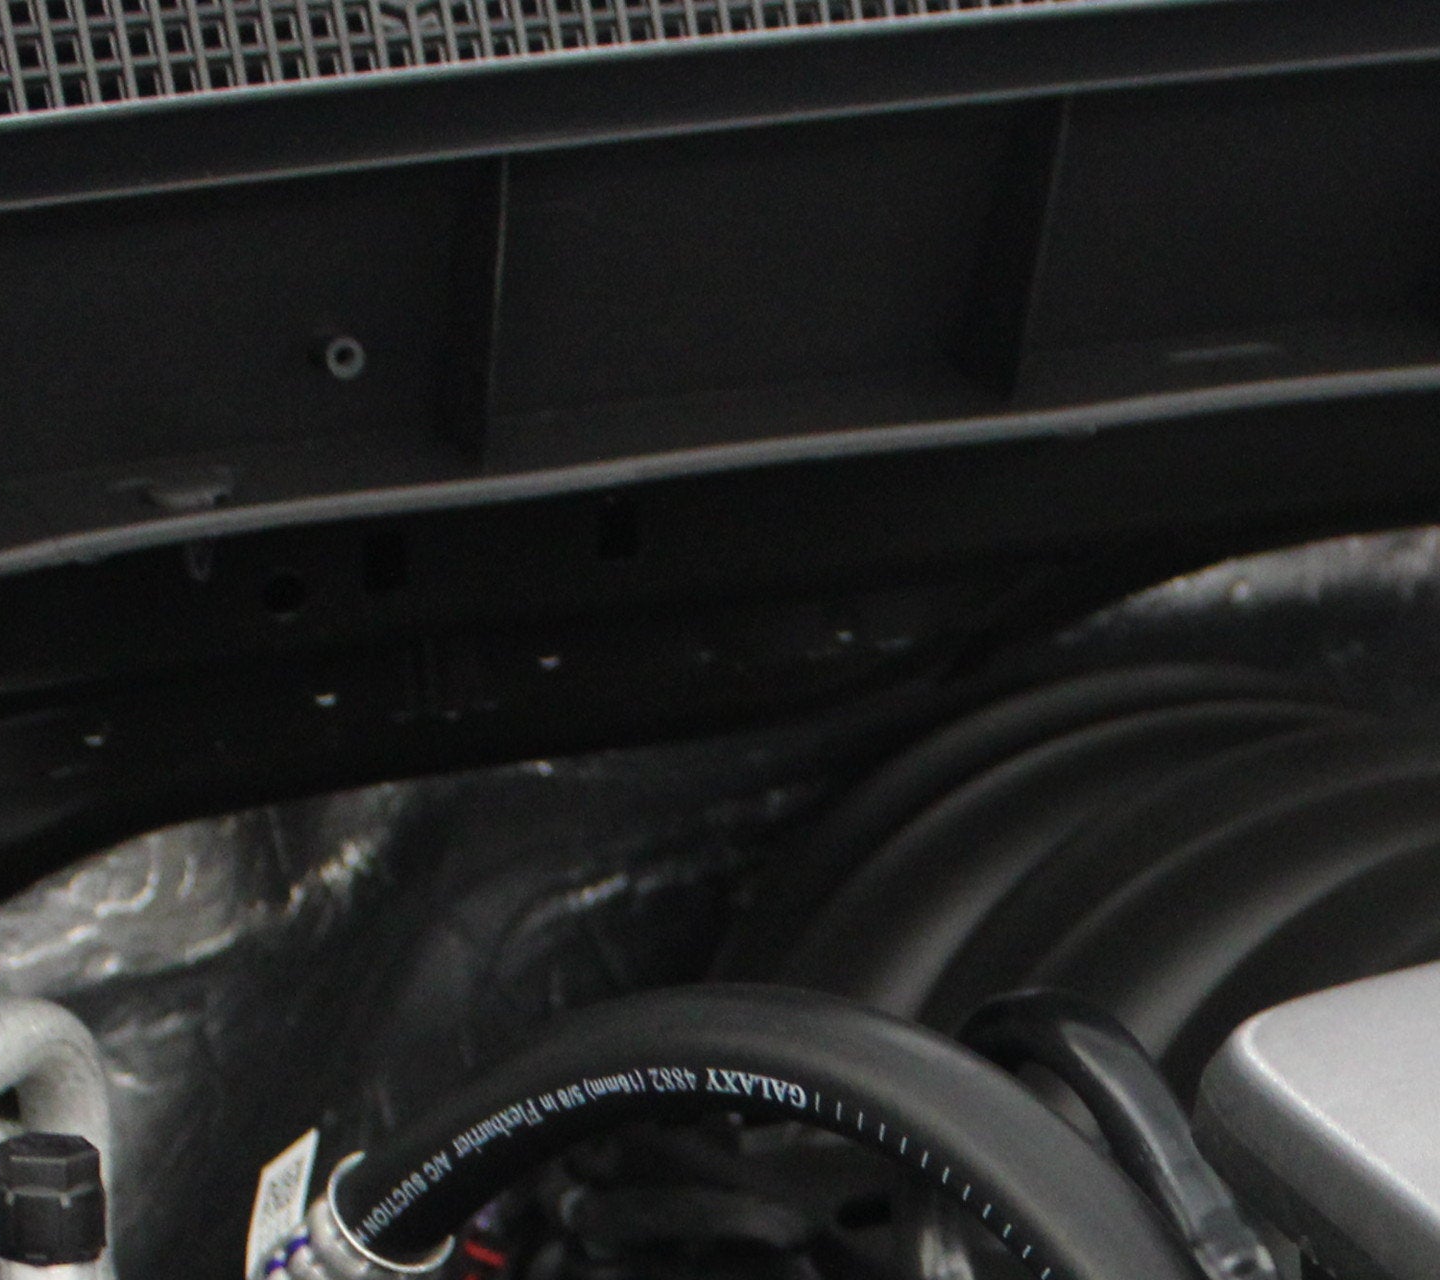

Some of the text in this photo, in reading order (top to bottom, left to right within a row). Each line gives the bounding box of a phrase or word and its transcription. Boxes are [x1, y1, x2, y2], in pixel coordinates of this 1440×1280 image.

[583, 1068, 646, 1100] (16mm)
[647, 1066, 697, 1092] 4882
[706, 1067, 808, 1110] GALAXY
[538, 1093, 560, 1113] in
[557, 1084, 585, 1109] 5/8
[452, 1097, 543, 1158] Flexbarrier
[422, 1151, 452, 1182] A/C
[362, 1171, 428, 1236] SUCTION
